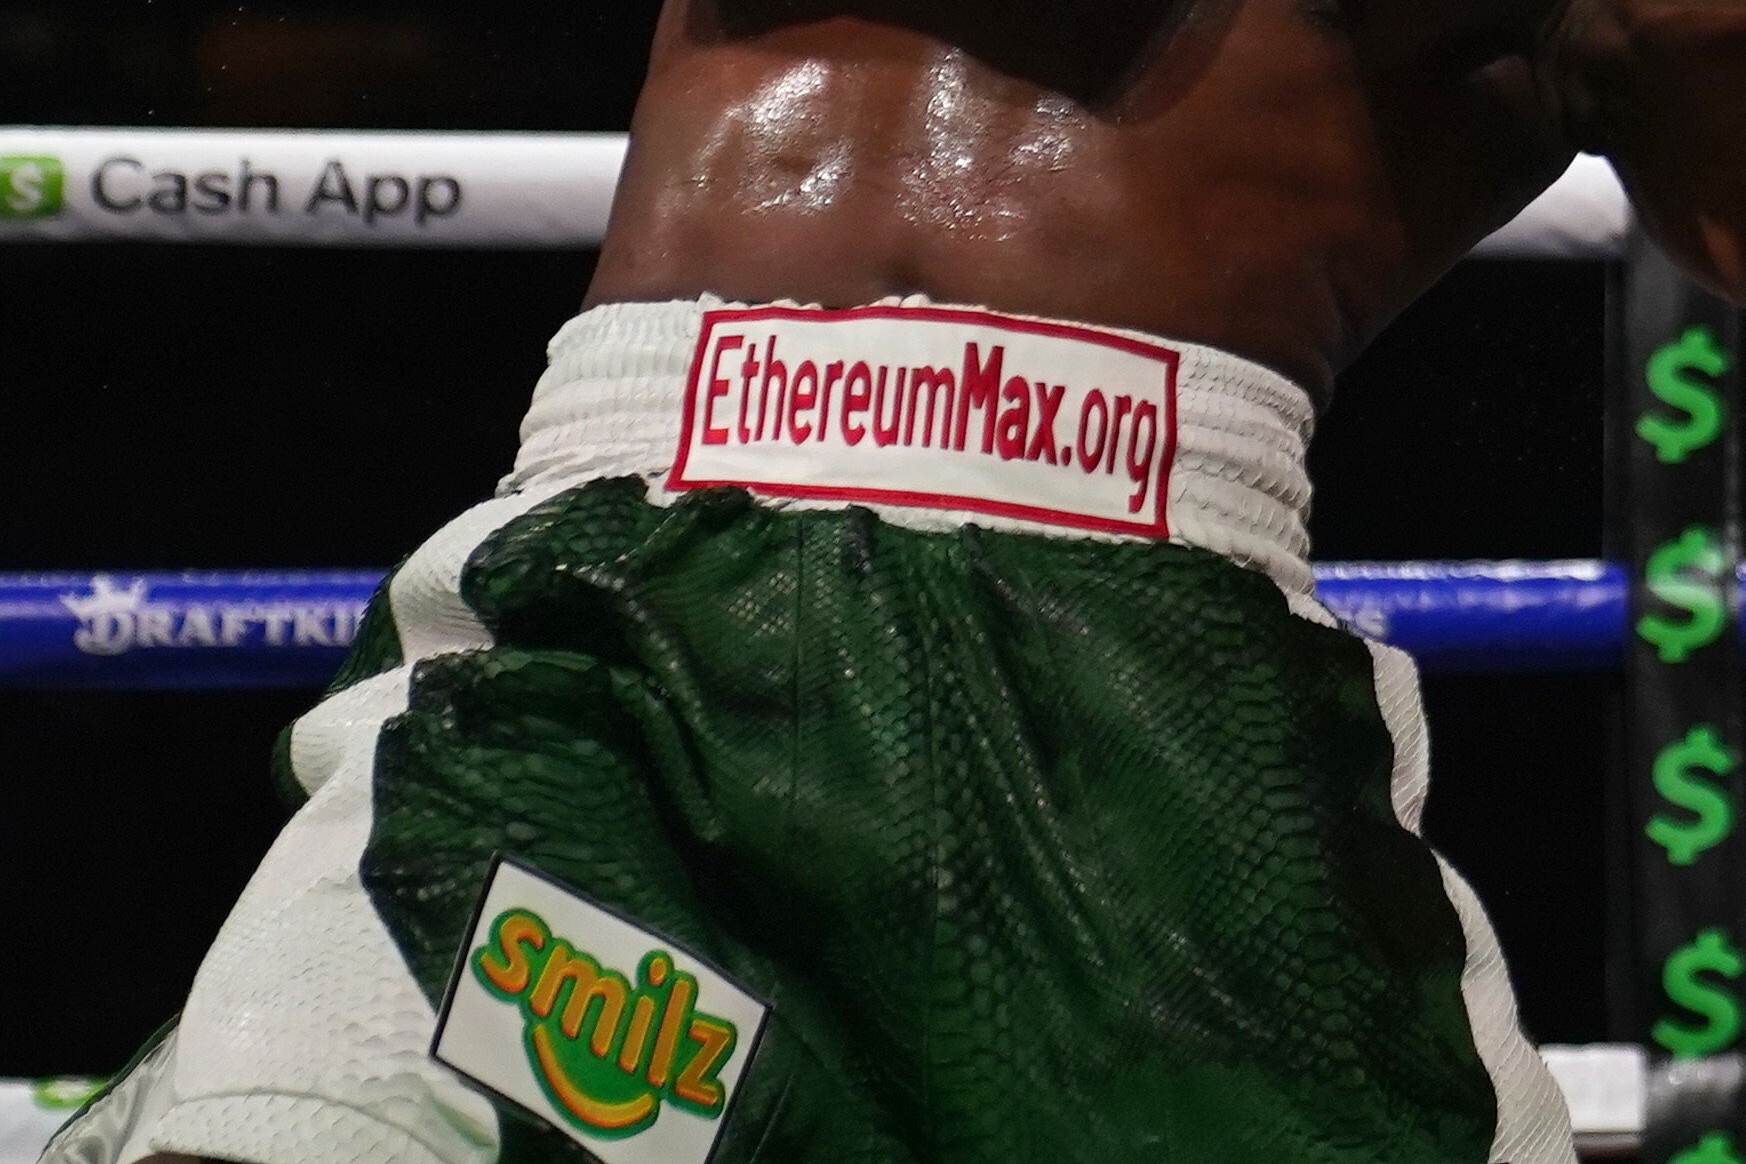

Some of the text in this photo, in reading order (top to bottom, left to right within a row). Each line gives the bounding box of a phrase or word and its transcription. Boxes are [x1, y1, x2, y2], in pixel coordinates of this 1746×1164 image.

[91, 157, 462, 225] Cash App
[702, 334, 1158, 513] EthereumMax.org
[73, 600, 366, 656] DRAFTKI
[474, 910, 735, 1117] smilz
